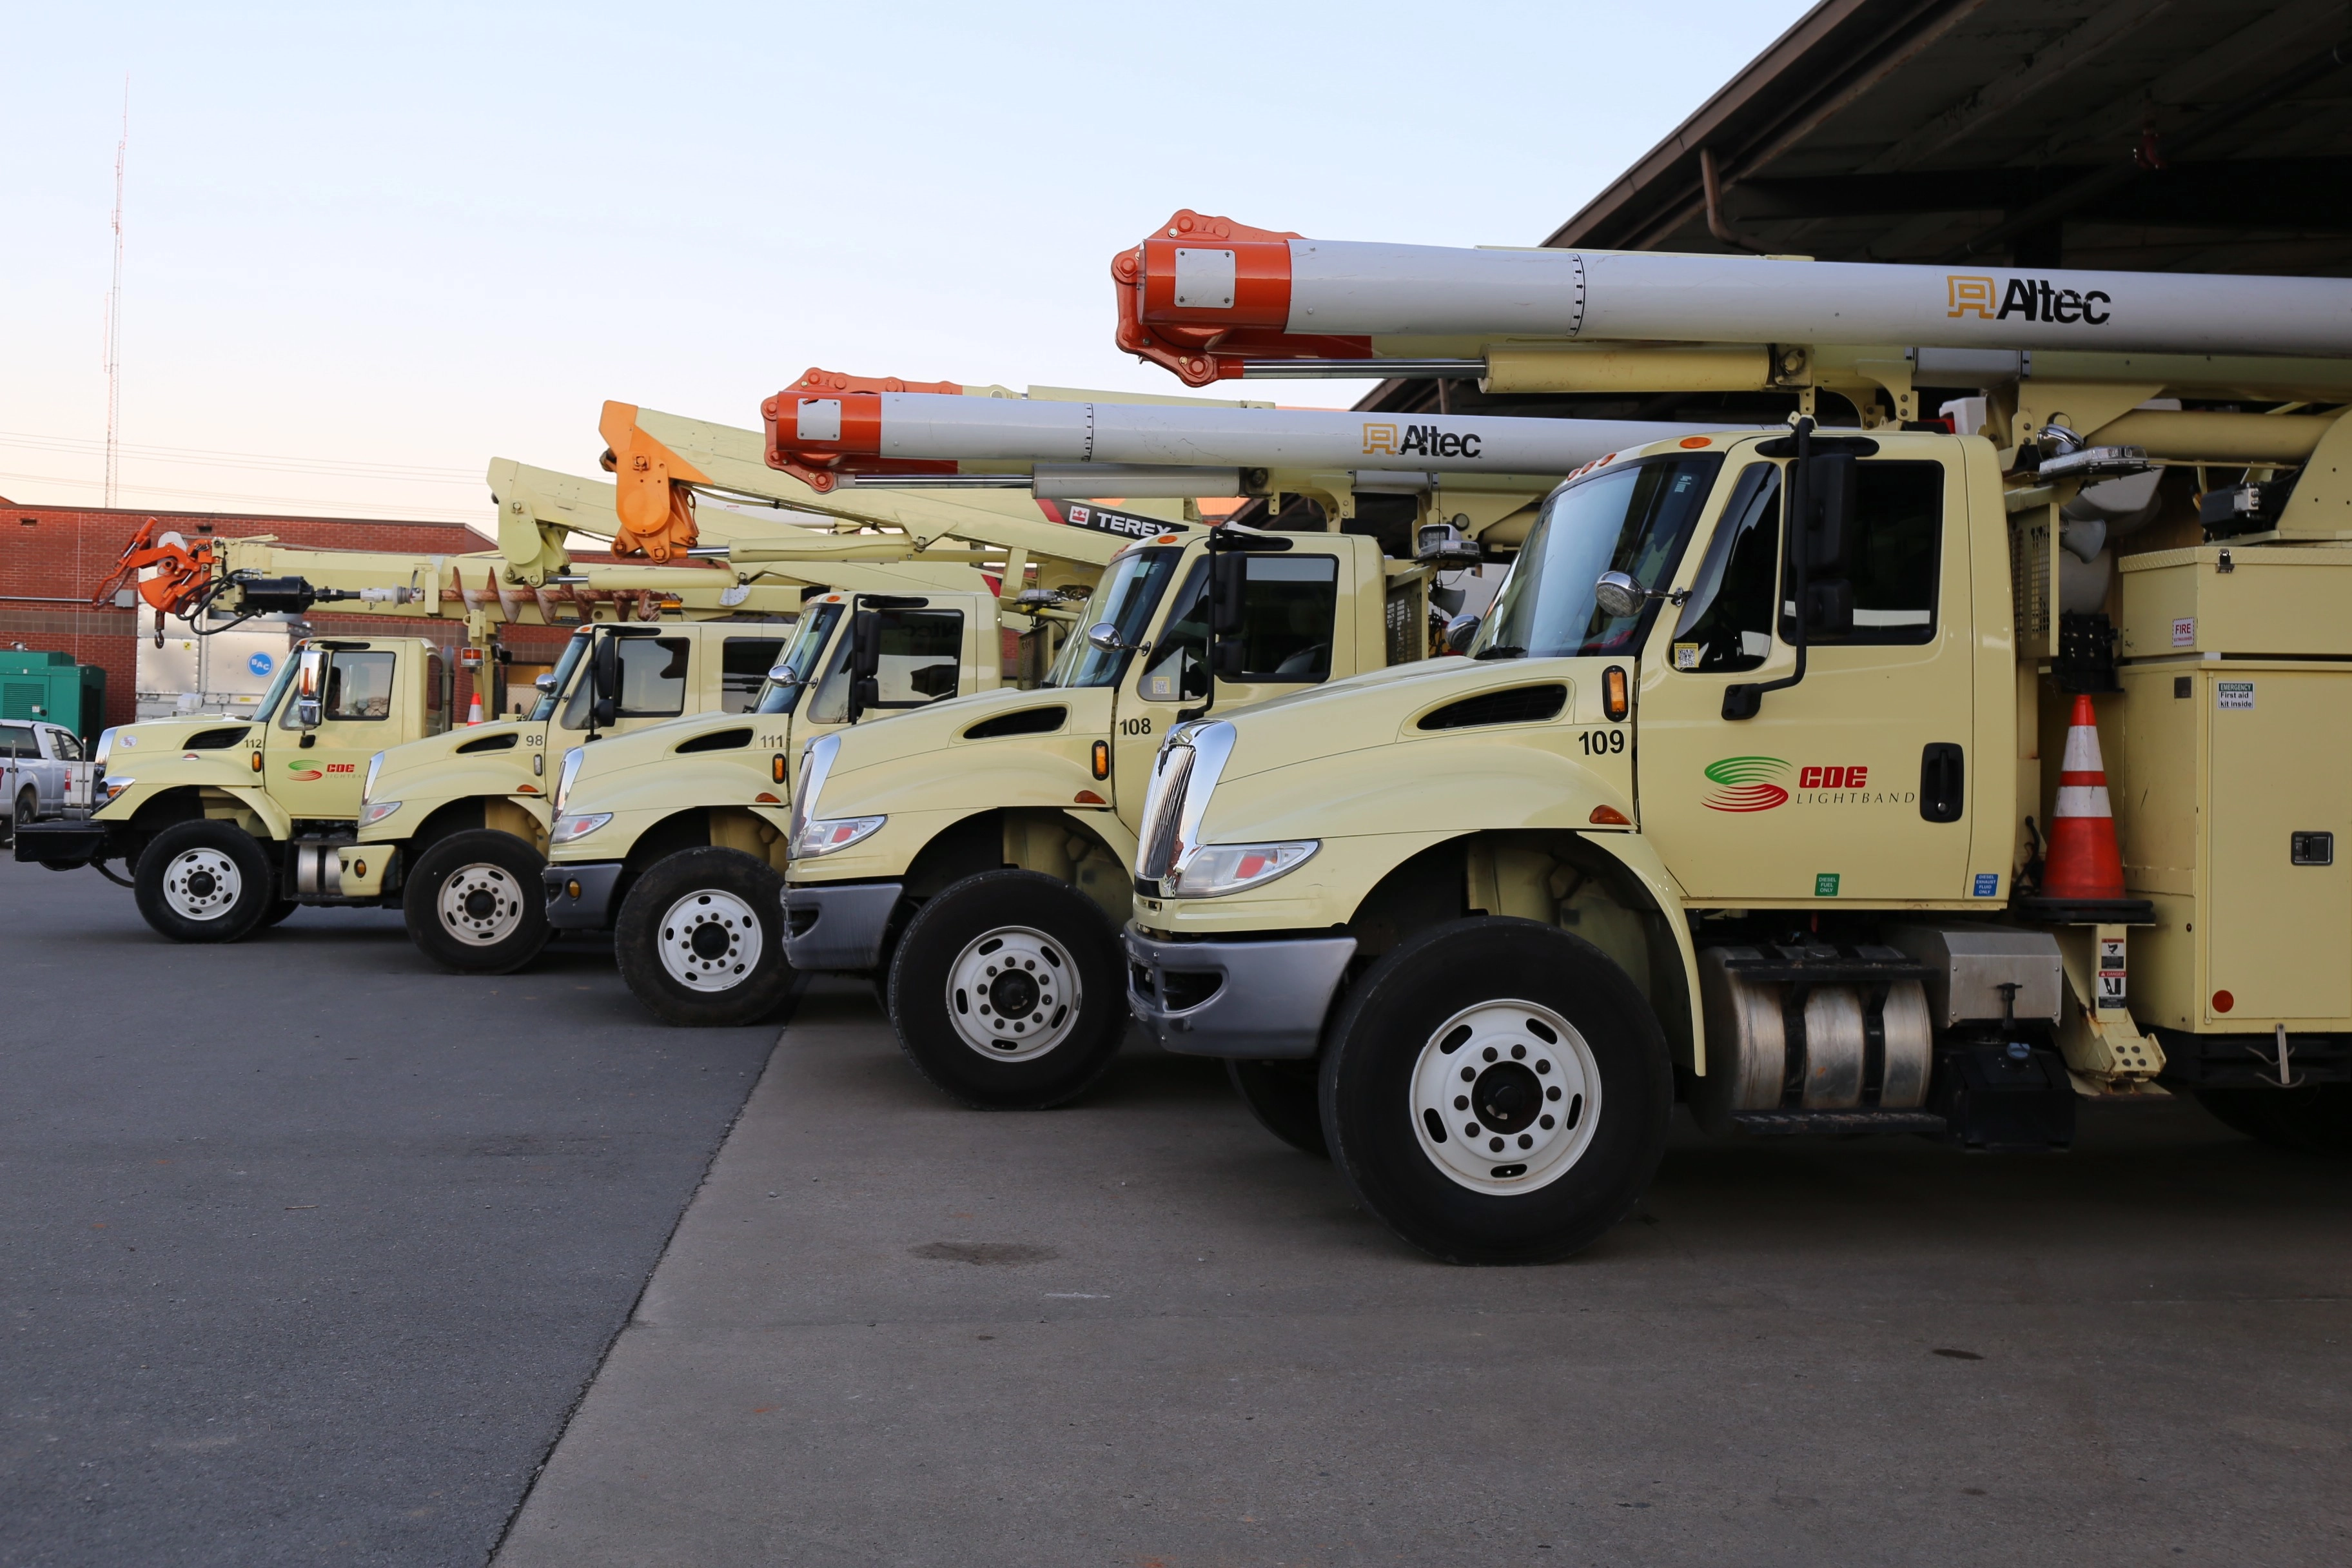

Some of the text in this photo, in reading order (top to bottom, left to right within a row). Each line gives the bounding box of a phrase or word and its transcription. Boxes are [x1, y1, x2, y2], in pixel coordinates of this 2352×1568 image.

[1996, 279, 2111, 325] Altec
[1398, 425, 1482, 458] Altec
[1097, 512, 1171, 536] TEREX
[2175, 623, 2191, 634] FIRE
[251, 659, 270, 671] BAC
[1119, 718, 1151, 736] 108
[244, 739, 262, 748] 112
[526, 735, 543, 747] 98
[760, 735, 782, 748] 111
[1578, 729, 1624, 756] 109
[326, 764, 355, 772] CDE
[1799, 766, 1868, 788] CDE
[1797, 792, 1915, 804] LIGHTBAND
